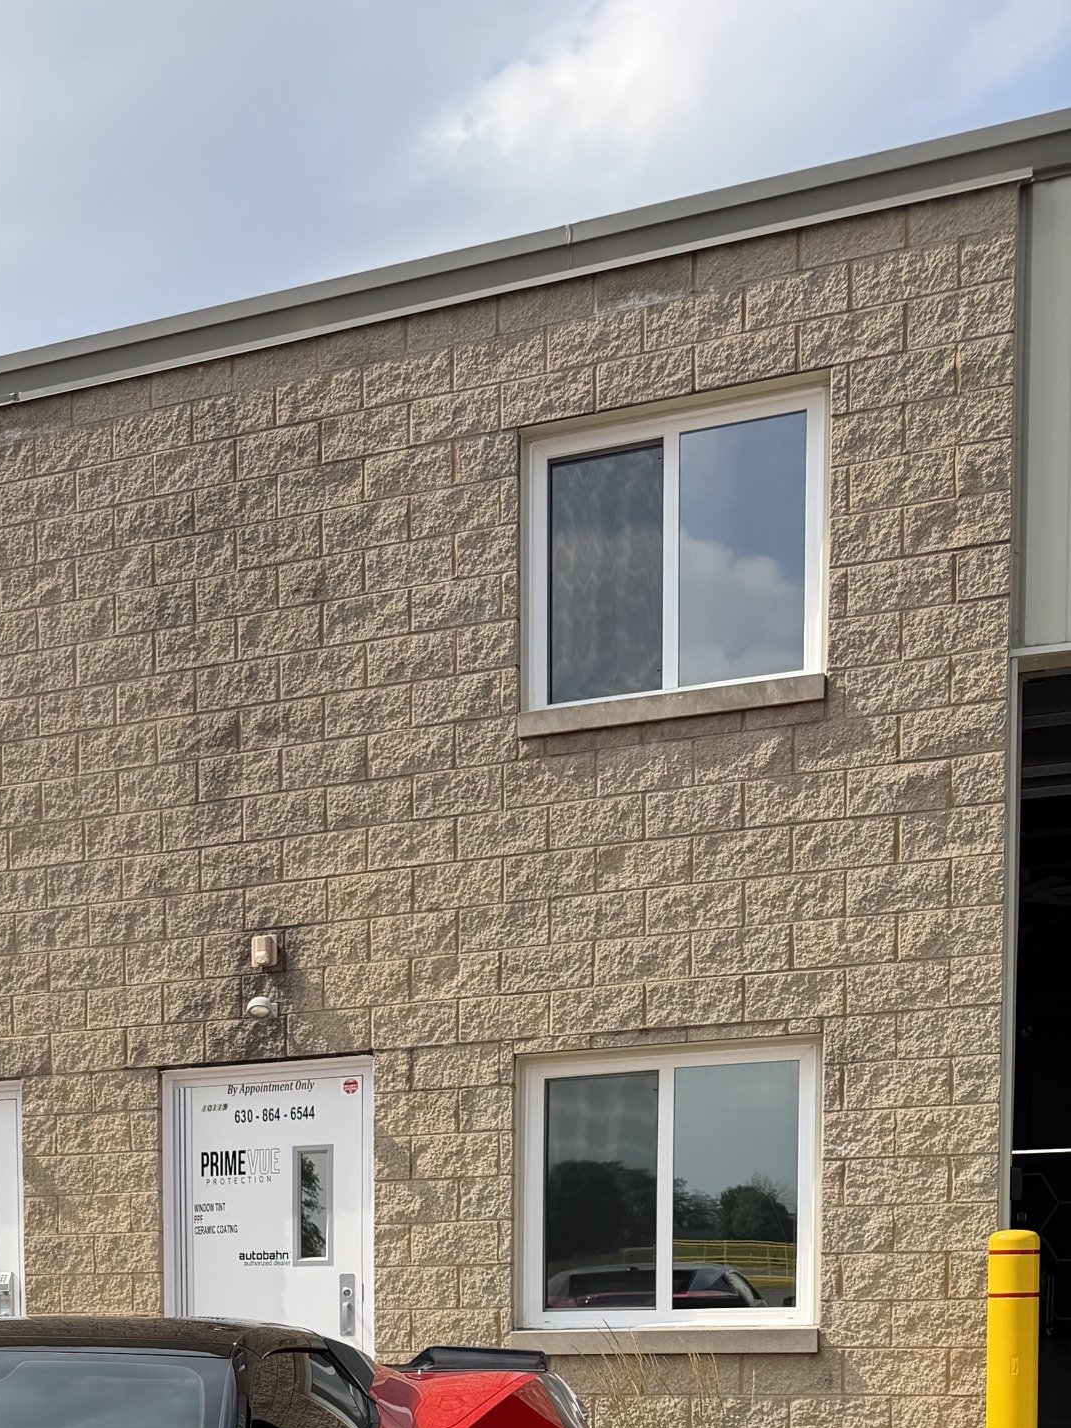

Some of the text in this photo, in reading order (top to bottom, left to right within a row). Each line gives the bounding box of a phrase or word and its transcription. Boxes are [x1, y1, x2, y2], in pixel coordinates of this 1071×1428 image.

[227, 1079, 315, 1097] By Appointment Only
[202, 1104, 228, 1112] 10119
[234, 1110, 253, 1124] 630
[262, 1107, 280, 1122] 864
[290, 1106, 315, 1120] 6544
[206, 1176, 272, 1186] PROTECTION
[194, 1202, 226, 1213] WINDOW TINT
[194, 1214, 203, 1224] PPF
[194, 1224, 238, 1235] CERAMIC COATING
[239, 1250, 289, 1261] autobahn
